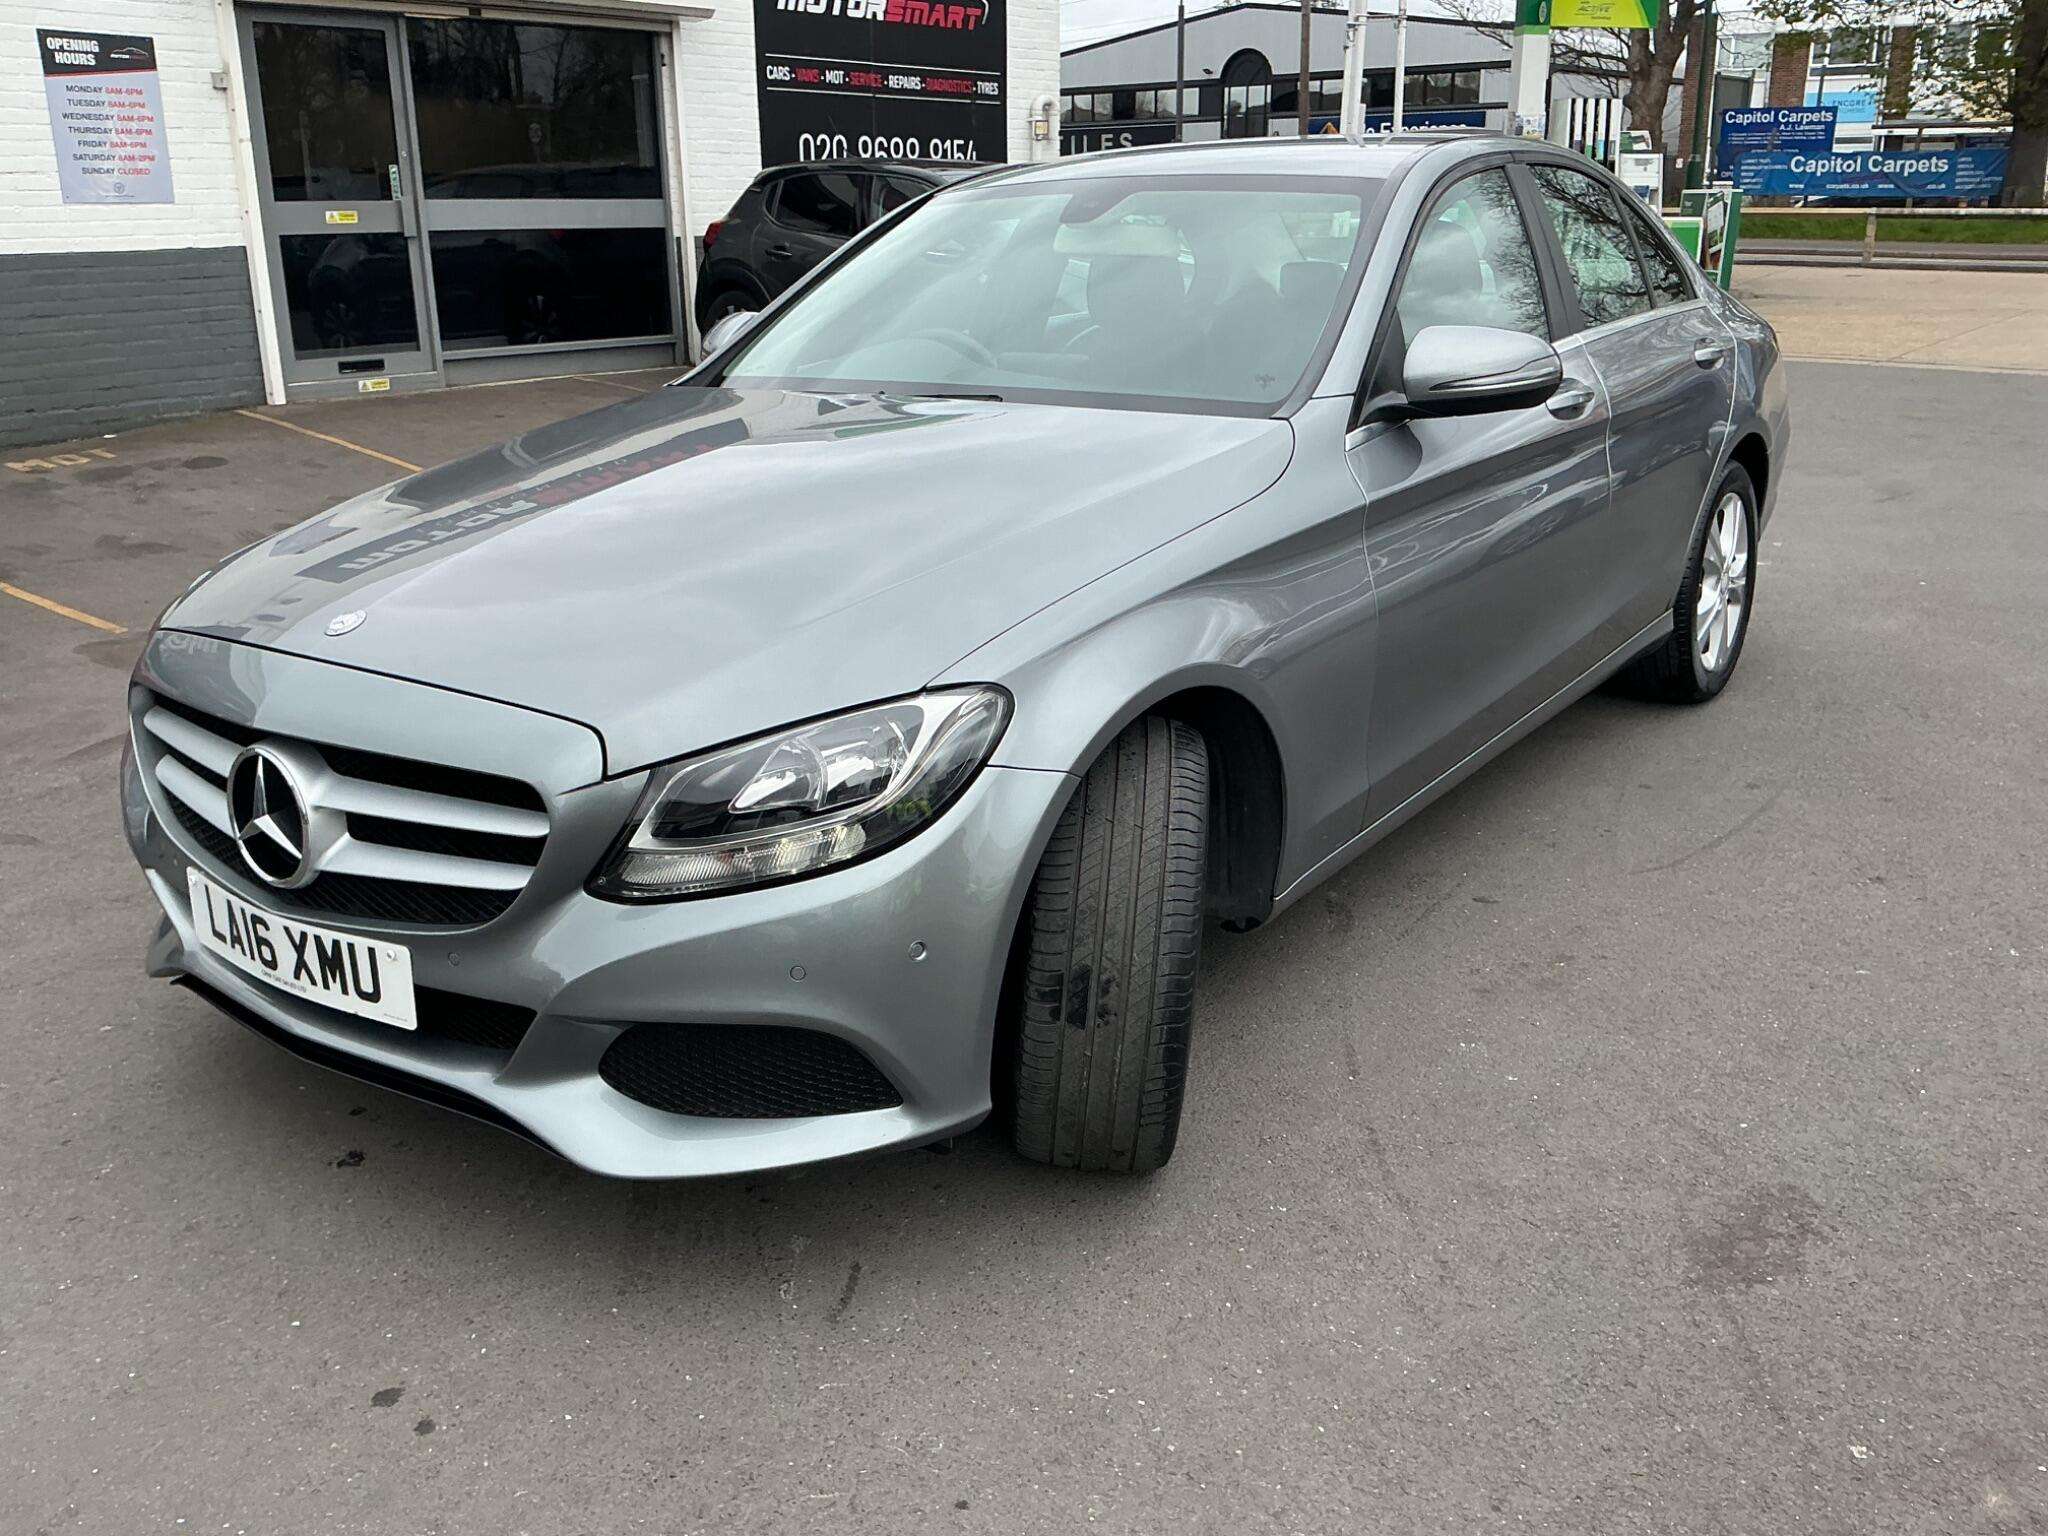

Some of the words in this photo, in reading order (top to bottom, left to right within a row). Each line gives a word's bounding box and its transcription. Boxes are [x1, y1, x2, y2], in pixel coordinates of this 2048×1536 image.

[46, 37, 99, 53] OPENING
[54, 51, 96, 66] HOURS
[766, 65, 790, 81] CARS
[795, 68, 819, 83] VANS
[826, 69, 844, 84] MOT
[850, 72, 882, 88] SERVICE
[889, 75, 921, 90] REPAIRS
[977, 81, 999, 95] TYRES
[65, 85, 102, 94] MONDAY
[67, 99, 105, 107] TUESDAY
[62, 112, 114, 121] WEDNESDAY
[1725, 110, 1774, 126] Capitol
[1778, 110, 1834, 125] Carpets
[68, 126, 112, 135] THURSDAY
[77, 140, 107, 148] FRIDAY
[72, 153, 116, 161] SATURDAY
[1790, 155, 1862, 176] Capitol
[1868, 155, 1949, 176] Carpets
[81, 167, 115, 175] SUNDAY
[117, 168, 151, 176] CLOSED
[204, 884, 278, 971] LA16
[283, 925, 382, 1004] XMU
